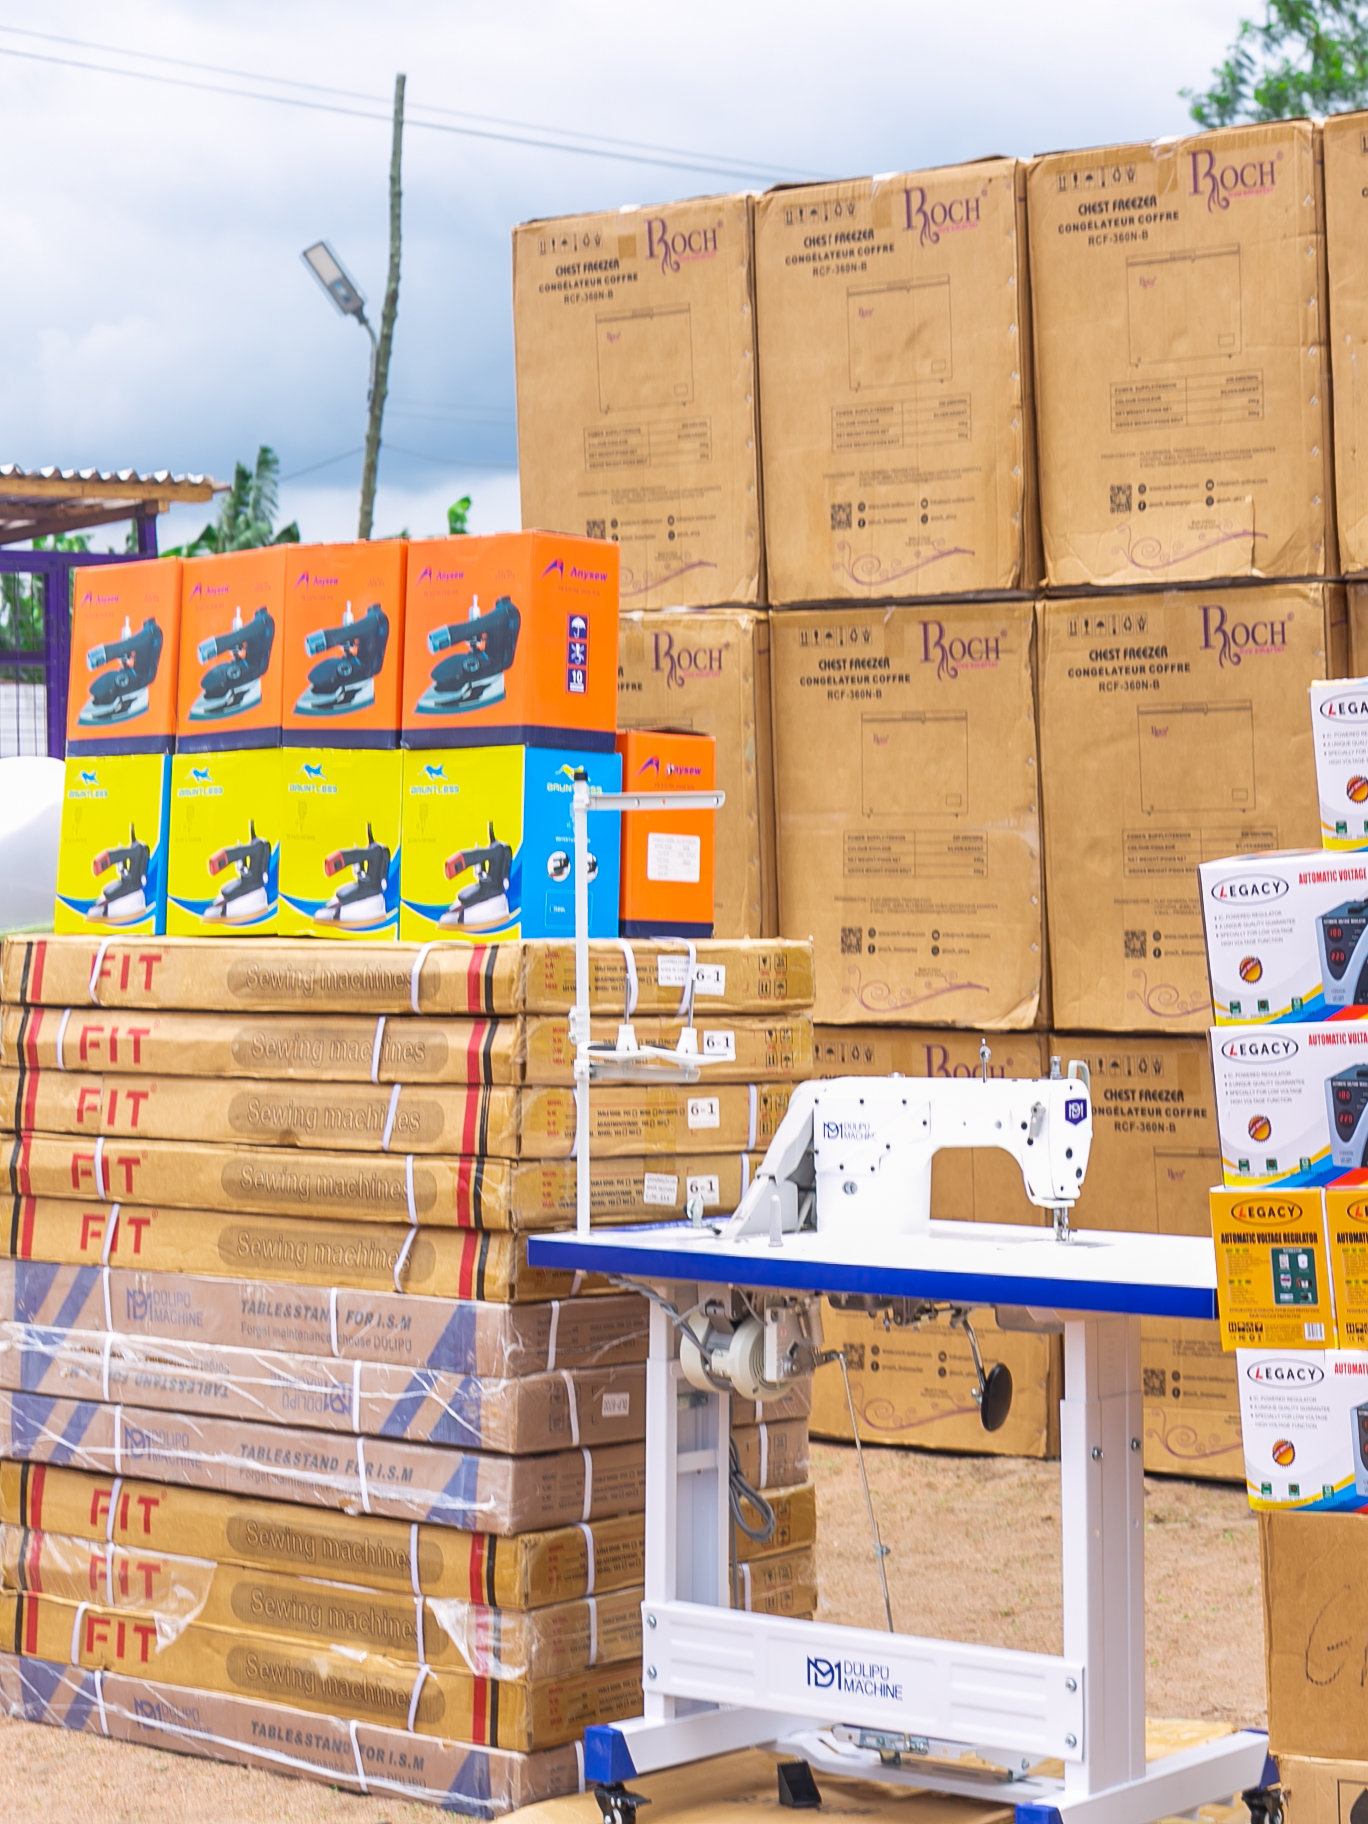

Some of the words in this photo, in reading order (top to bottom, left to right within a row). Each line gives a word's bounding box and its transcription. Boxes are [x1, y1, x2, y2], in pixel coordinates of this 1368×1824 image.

[1189, 150, 1276, 213] ROCH
[902, 187, 980, 247] ROCH
[1078, 201, 1109, 216] CHEST
[1112, 195, 1158, 212] FREEZER
[645, 217, 718, 276] ROCH
[570, 567, 608, 582] Anysew
[919, 621, 1001, 681] ROCH
[1088, 648, 1120, 661] CHEST
[1122, 646, 1169, 659] FREEZER
[1199, 605, 1288, 668] ROCH
[652, 631, 724, 690] ROCH
[818, 658, 847, 671] CHEST
[849, 656, 891, 670] FREEZER
[1067, 665, 1146, 679] CONGÉLATEUR
[1148, 663, 1191, 675] COFFRE
[799, 674, 871, 687] CONGÉLATEUR
[872, 673, 911, 684] COFFRE
[1219, 882, 1281, 898] LEGACY
[92, 954, 162, 992] FIT
[245, 958, 315, 991] Sewing
[320, 963, 413, 993] machines
[79, 1025, 150, 1064] FIT
[1230, 1042, 1291, 1056] LEGACY
[77, 1088, 149, 1127] FIT
[1092, 1104, 1163, 1118] ONGÉLATEUR
[1165, 1108, 1207, 1119] COFFRE
[1104, 1089, 1136, 1103] CHEST
[1138, 1089, 1184, 1103] FREEZER
[71, 1154, 141, 1195] FIT
[240, 1165, 310, 1197] Sewing
[316, 1169, 409, 1201] machines
[1238, 1206, 1295, 1219] LEGACY
[80, 1214, 151, 1255] FIT
[241, 1299, 330, 1322] TABLE&STAN
[346, 1309, 374, 1326] FOR
[1255, 1367, 1316, 1380] LEGACY
[239, 1444, 339, 1471] TABLE&STAND
[345, 1452, 374, 1474] FOR
[90, 1486, 160, 1535] FIT
[246, 1519, 317, 1562] Sewing
[88, 1553, 162, 1600] FIT
[248, 1587, 322, 1629] Sewing
[86, 1616, 157, 1663] FIT
[843, 1678, 904, 1701] MACHINE
